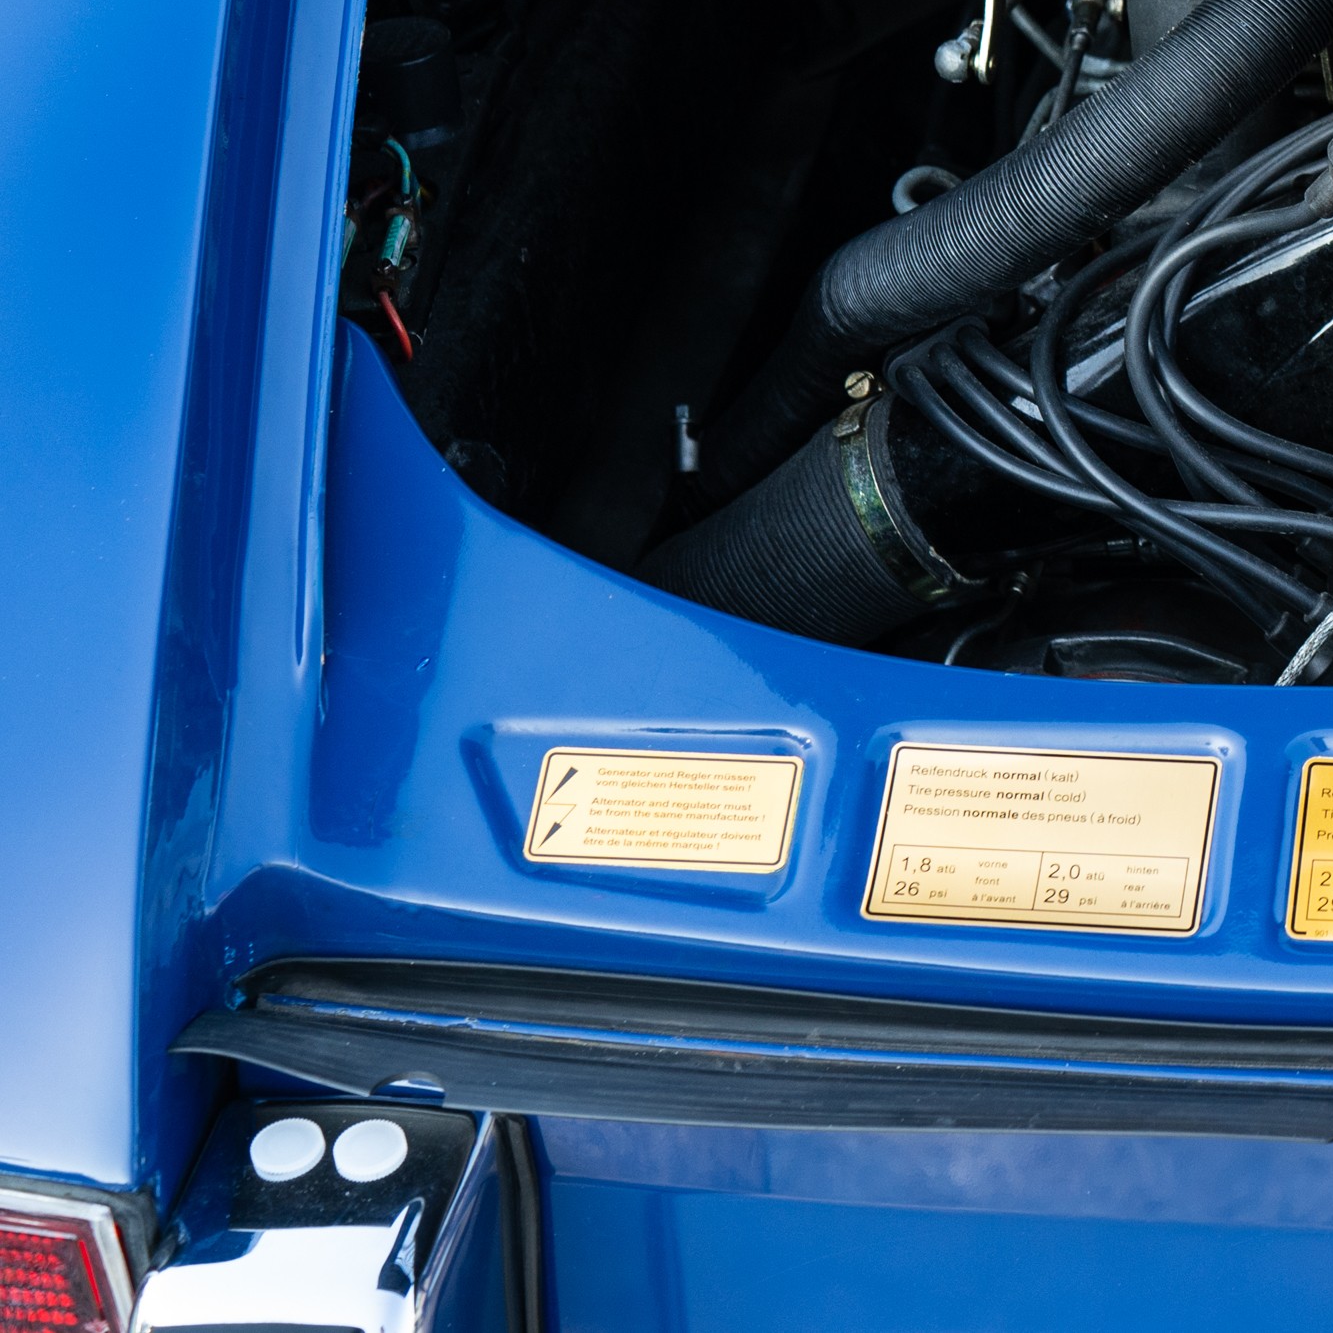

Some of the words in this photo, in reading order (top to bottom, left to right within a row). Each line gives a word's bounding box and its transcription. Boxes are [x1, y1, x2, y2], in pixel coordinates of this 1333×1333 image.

[597, 767, 652, 778] Generator
[653, 770, 675, 779] und
[676, 770, 712, 782] Regler
[910, 764, 988, 779] Reifendruck
[993, 771, 1041, 781] normal
[620, 779, 667, 789] gleichen
[668, 781, 720, 791] Hersteller
[908, 784, 932, 796] Tire
[933, 788, 991, 799] pressure
[996, 791, 1045, 801] normal
[591, 797, 641, 807] Alternator
[648, 800, 670, 808] and
[671, 801, 722, 811] regulator
[723, 803, 752, 811] must
[605, 808, 631, 817] from
[634, 809, 651, 818] the
[685, 812, 759, 822] manufacturer
[903, 803, 960, 817] Pression
[962, 809, 1019, 820] normale
[1021, 810, 1045, 821] des
[1047, 813, 1087, 823] pneus
[585, 826, 647, 836] Alternateur
[720, 831, 762, 841] doivent
[902, 856, 932, 874] 1,8
[978, 861, 1008, 869] vorne
[1048, 863, 1081, 881] 2,0
[1126, 865, 1159, 875] hinten
[974, 876, 1000, 886] front
[1123, 884, 1145, 892] rear
[893, 880, 920, 897] 26
[928, 890, 947, 900] psi
[1043, 888, 1070, 904] 29
[1078, 897, 1097, 907] psi
